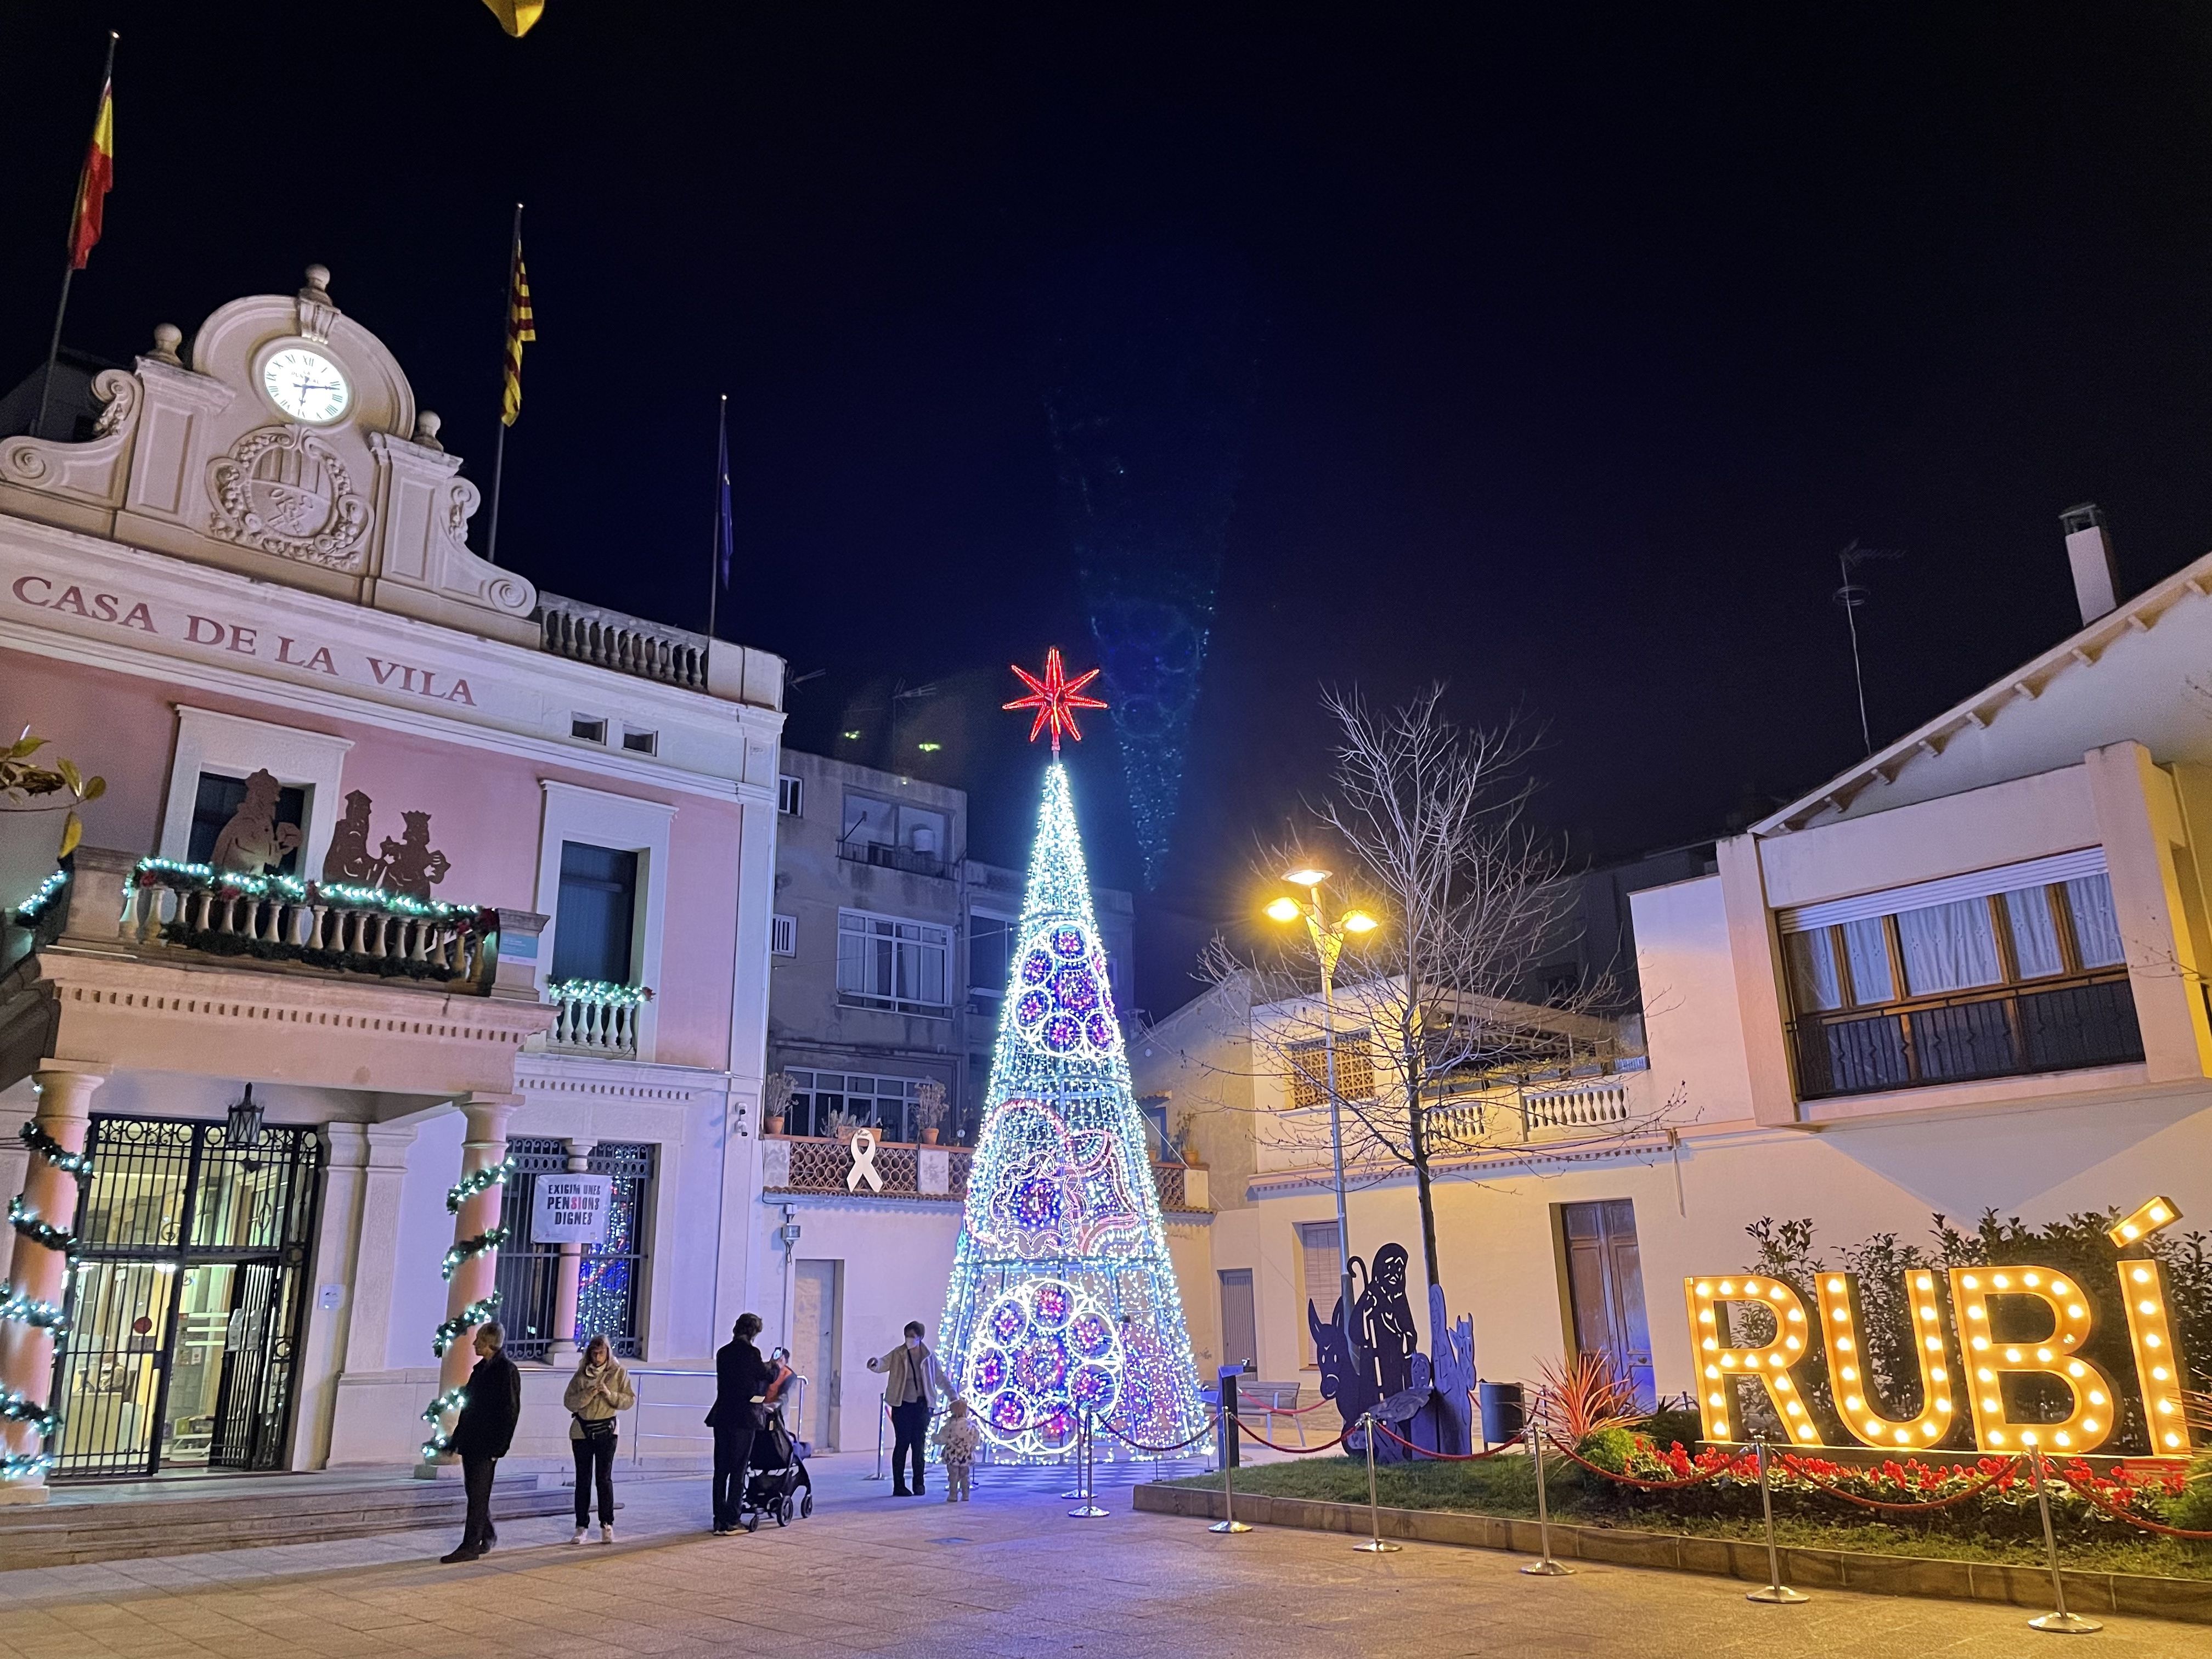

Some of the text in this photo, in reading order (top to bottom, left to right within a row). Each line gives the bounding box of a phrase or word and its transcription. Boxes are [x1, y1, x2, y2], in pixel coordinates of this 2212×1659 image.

[13, 576, 477, 707] CASA DE LA VILA
[549, 1184, 600, 1195] EXIGIM UNES
[547, 1197, 600, 1210] PENSIONS
[555, 1212, 592, 1225] DIGNES
[1684, 1196, 2191, 1457] RUBÍ
